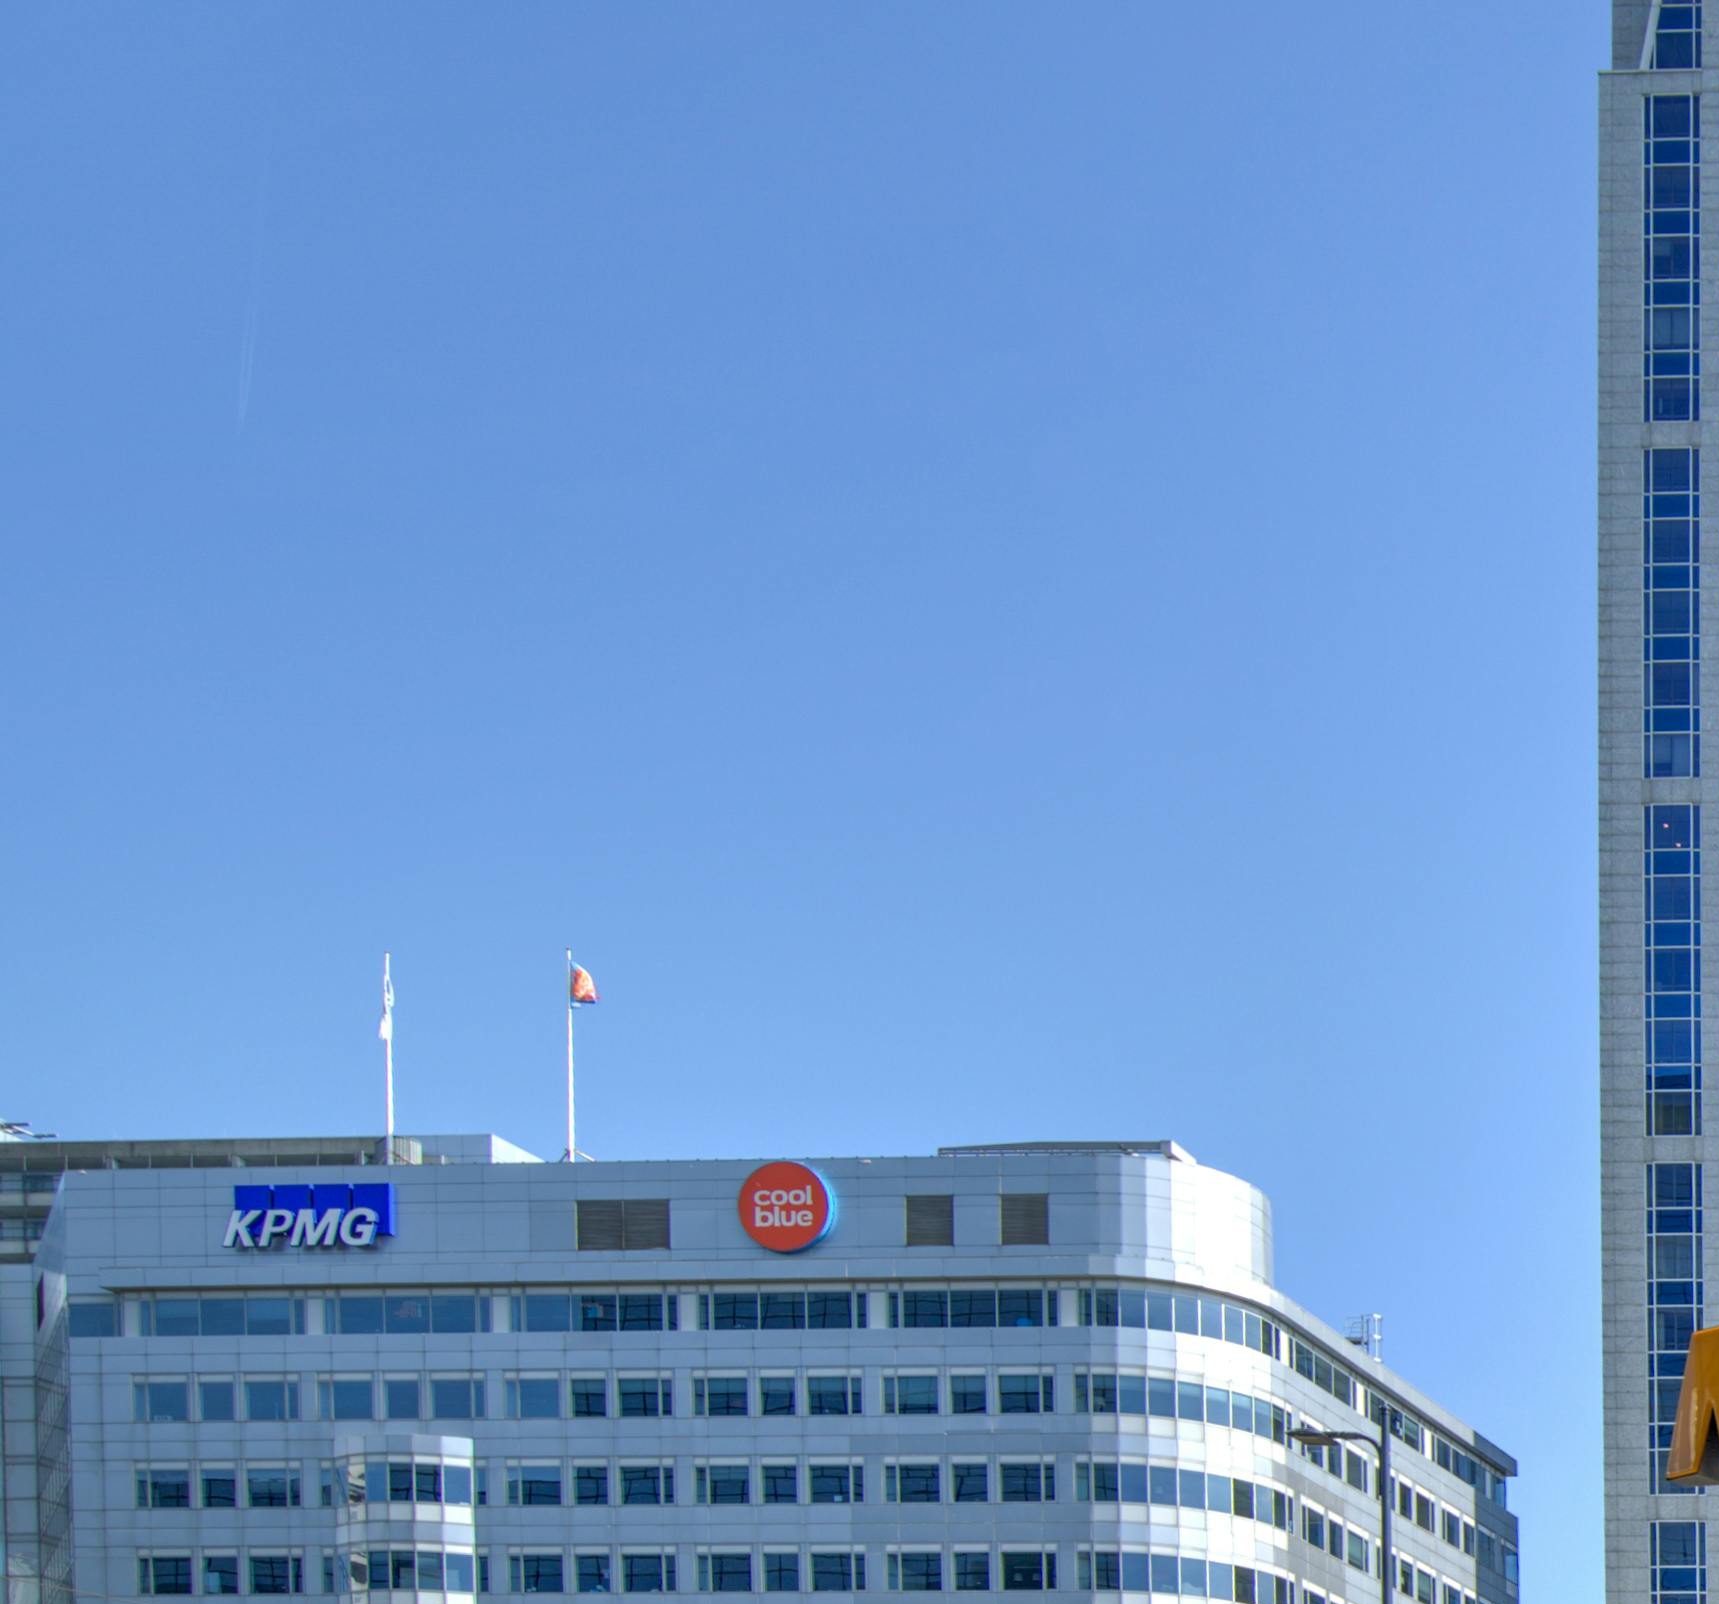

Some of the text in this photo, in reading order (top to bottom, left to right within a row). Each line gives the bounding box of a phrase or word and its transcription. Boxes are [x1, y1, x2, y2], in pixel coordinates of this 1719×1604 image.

[754, 1185, 813, 1206] cool
[224, 1207, 379, 1248] KPMG
[754, 1206, 813, 1228] blue
